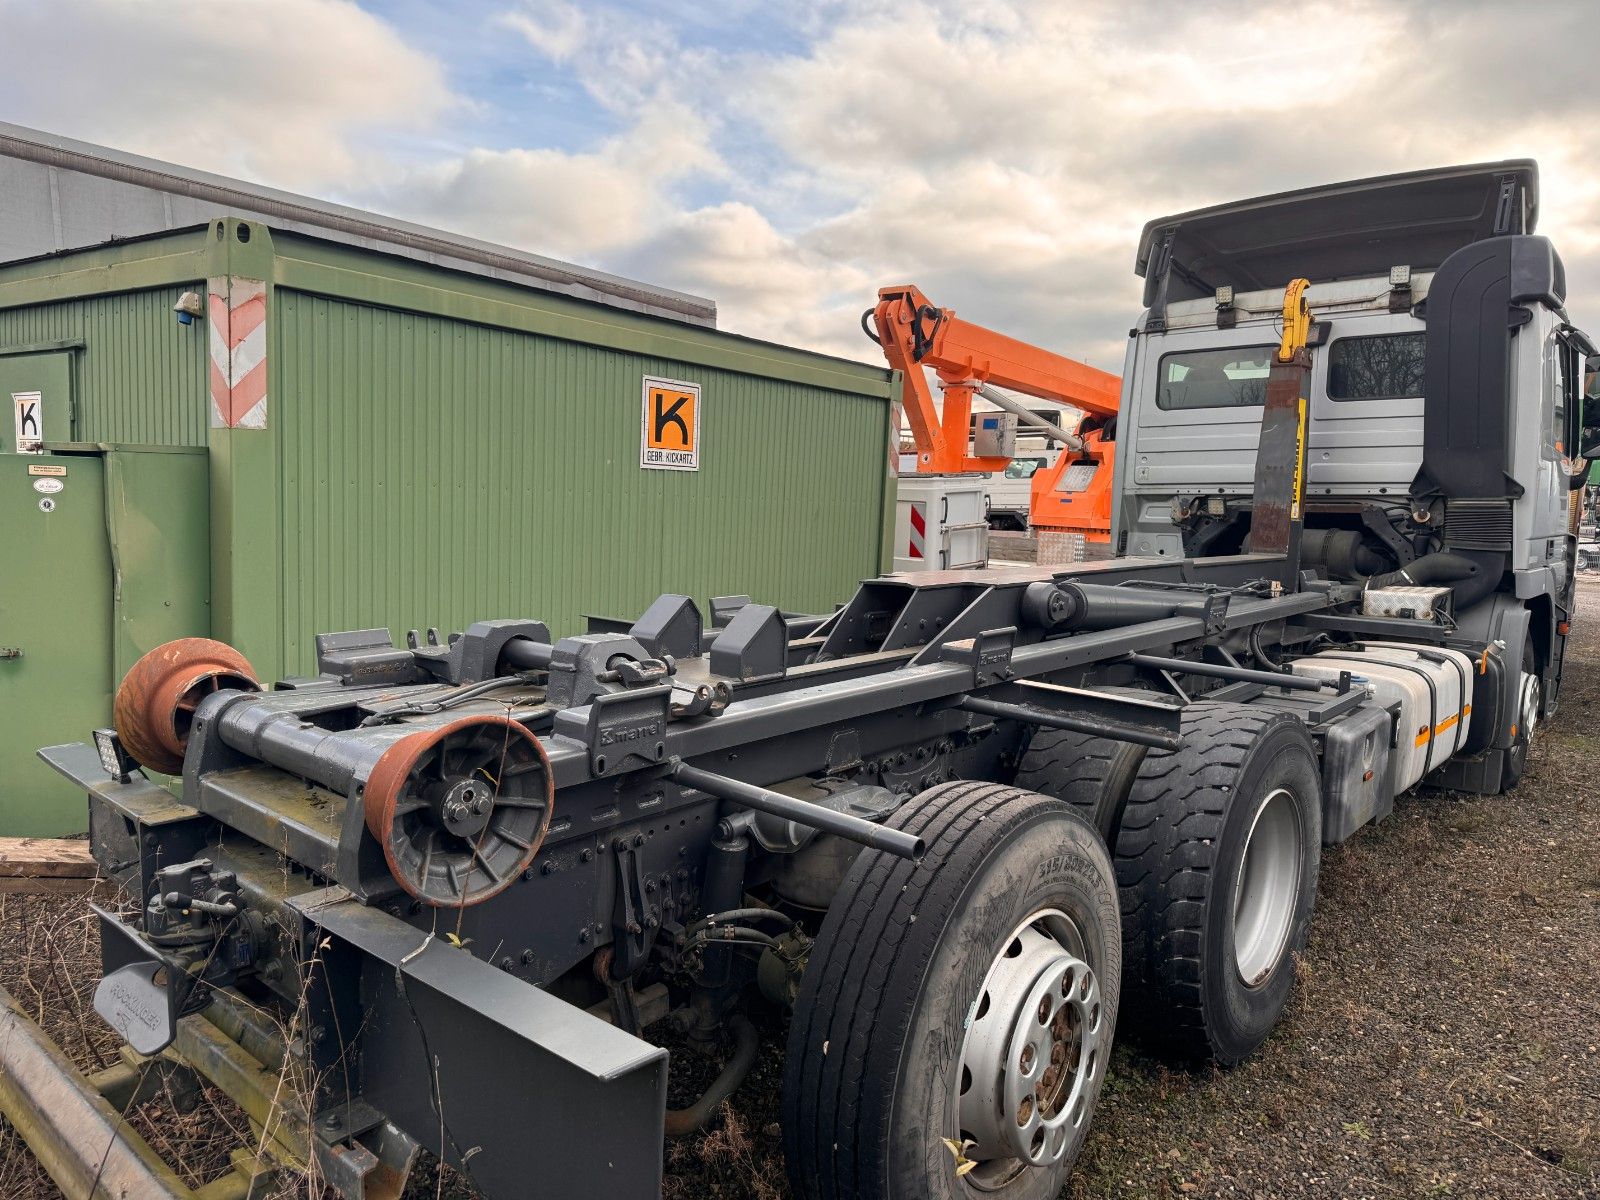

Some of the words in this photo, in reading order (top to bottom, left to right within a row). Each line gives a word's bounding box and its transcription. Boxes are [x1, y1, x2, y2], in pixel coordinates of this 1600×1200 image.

[20, 402, 37, 436] K
[655, 394, 689, 445] K
[647, 450, 664, 462] GEBR.
[666, 452, 693, 465] KICKARTZ
[110, 983, 161, 1031] ROCKINGER
